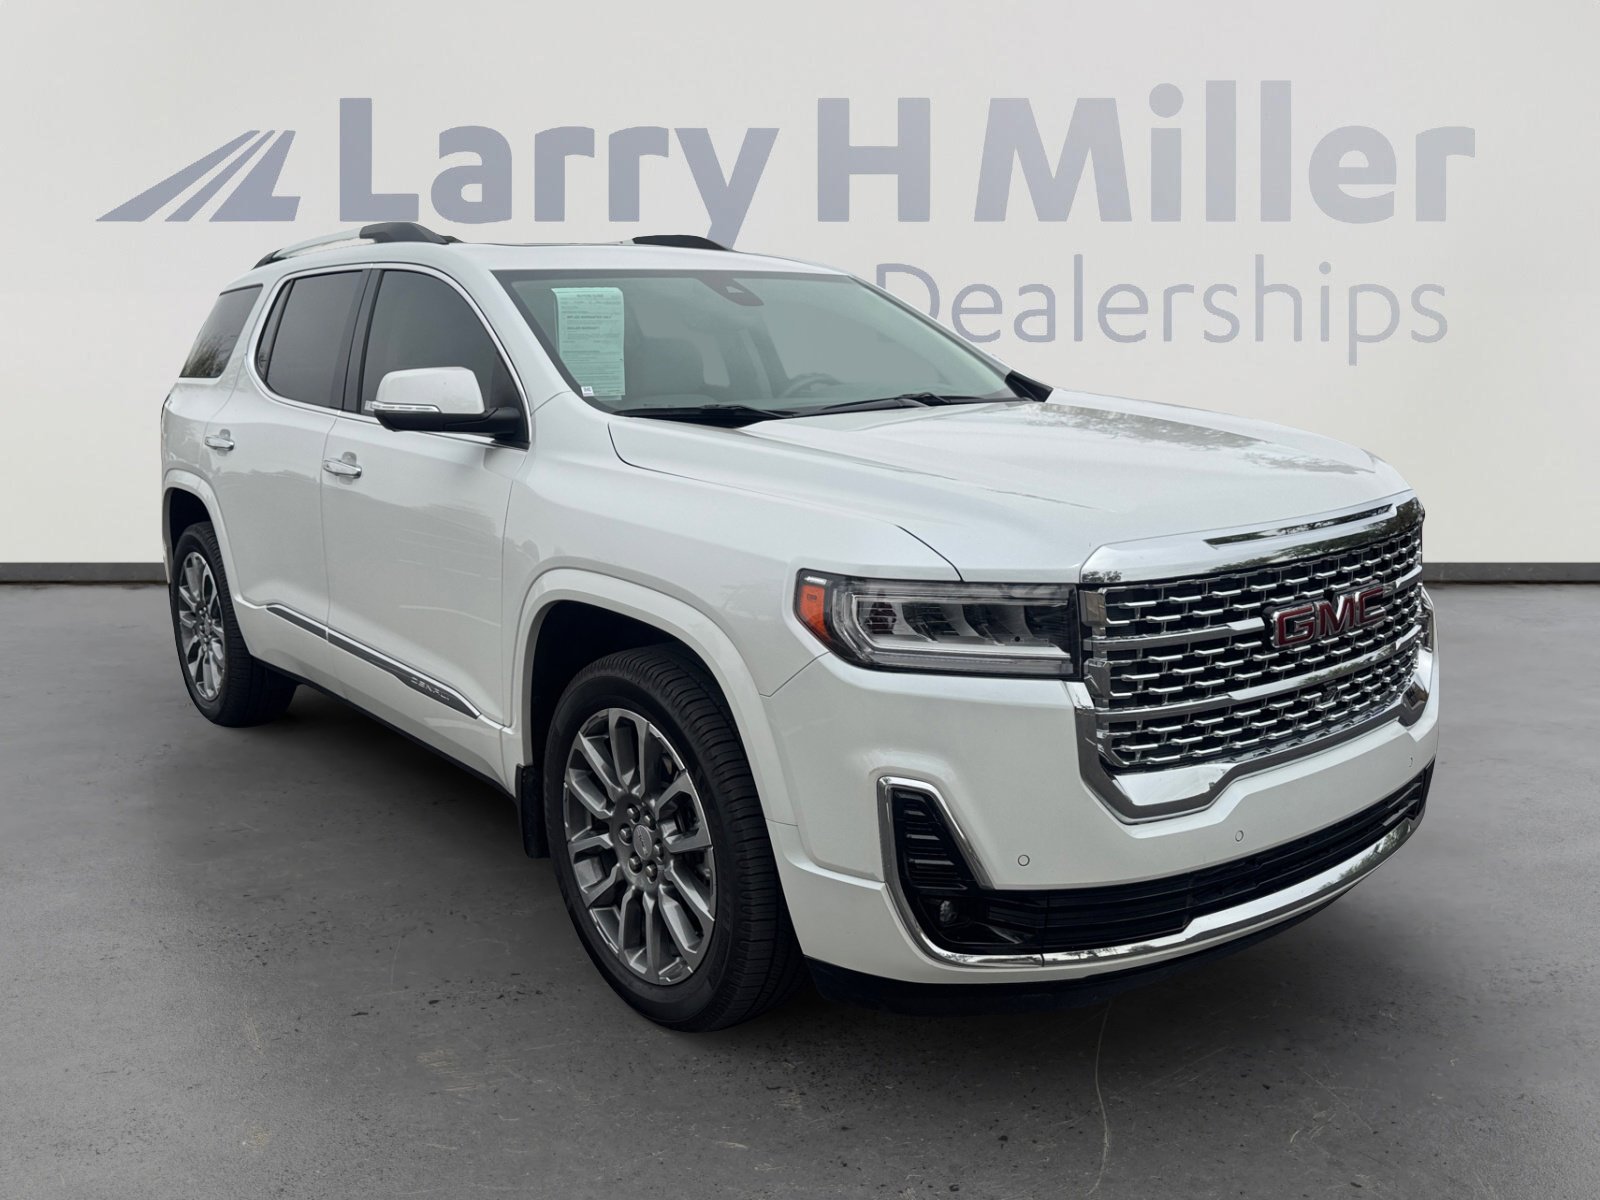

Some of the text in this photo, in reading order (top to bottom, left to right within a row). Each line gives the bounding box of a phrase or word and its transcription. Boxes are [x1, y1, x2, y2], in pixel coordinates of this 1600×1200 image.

[339, 80, 1476, 250] Larry H Miller
[876, 254, 1448, 366] Dealerships
[1272, 585, 1387, 648] GMC
